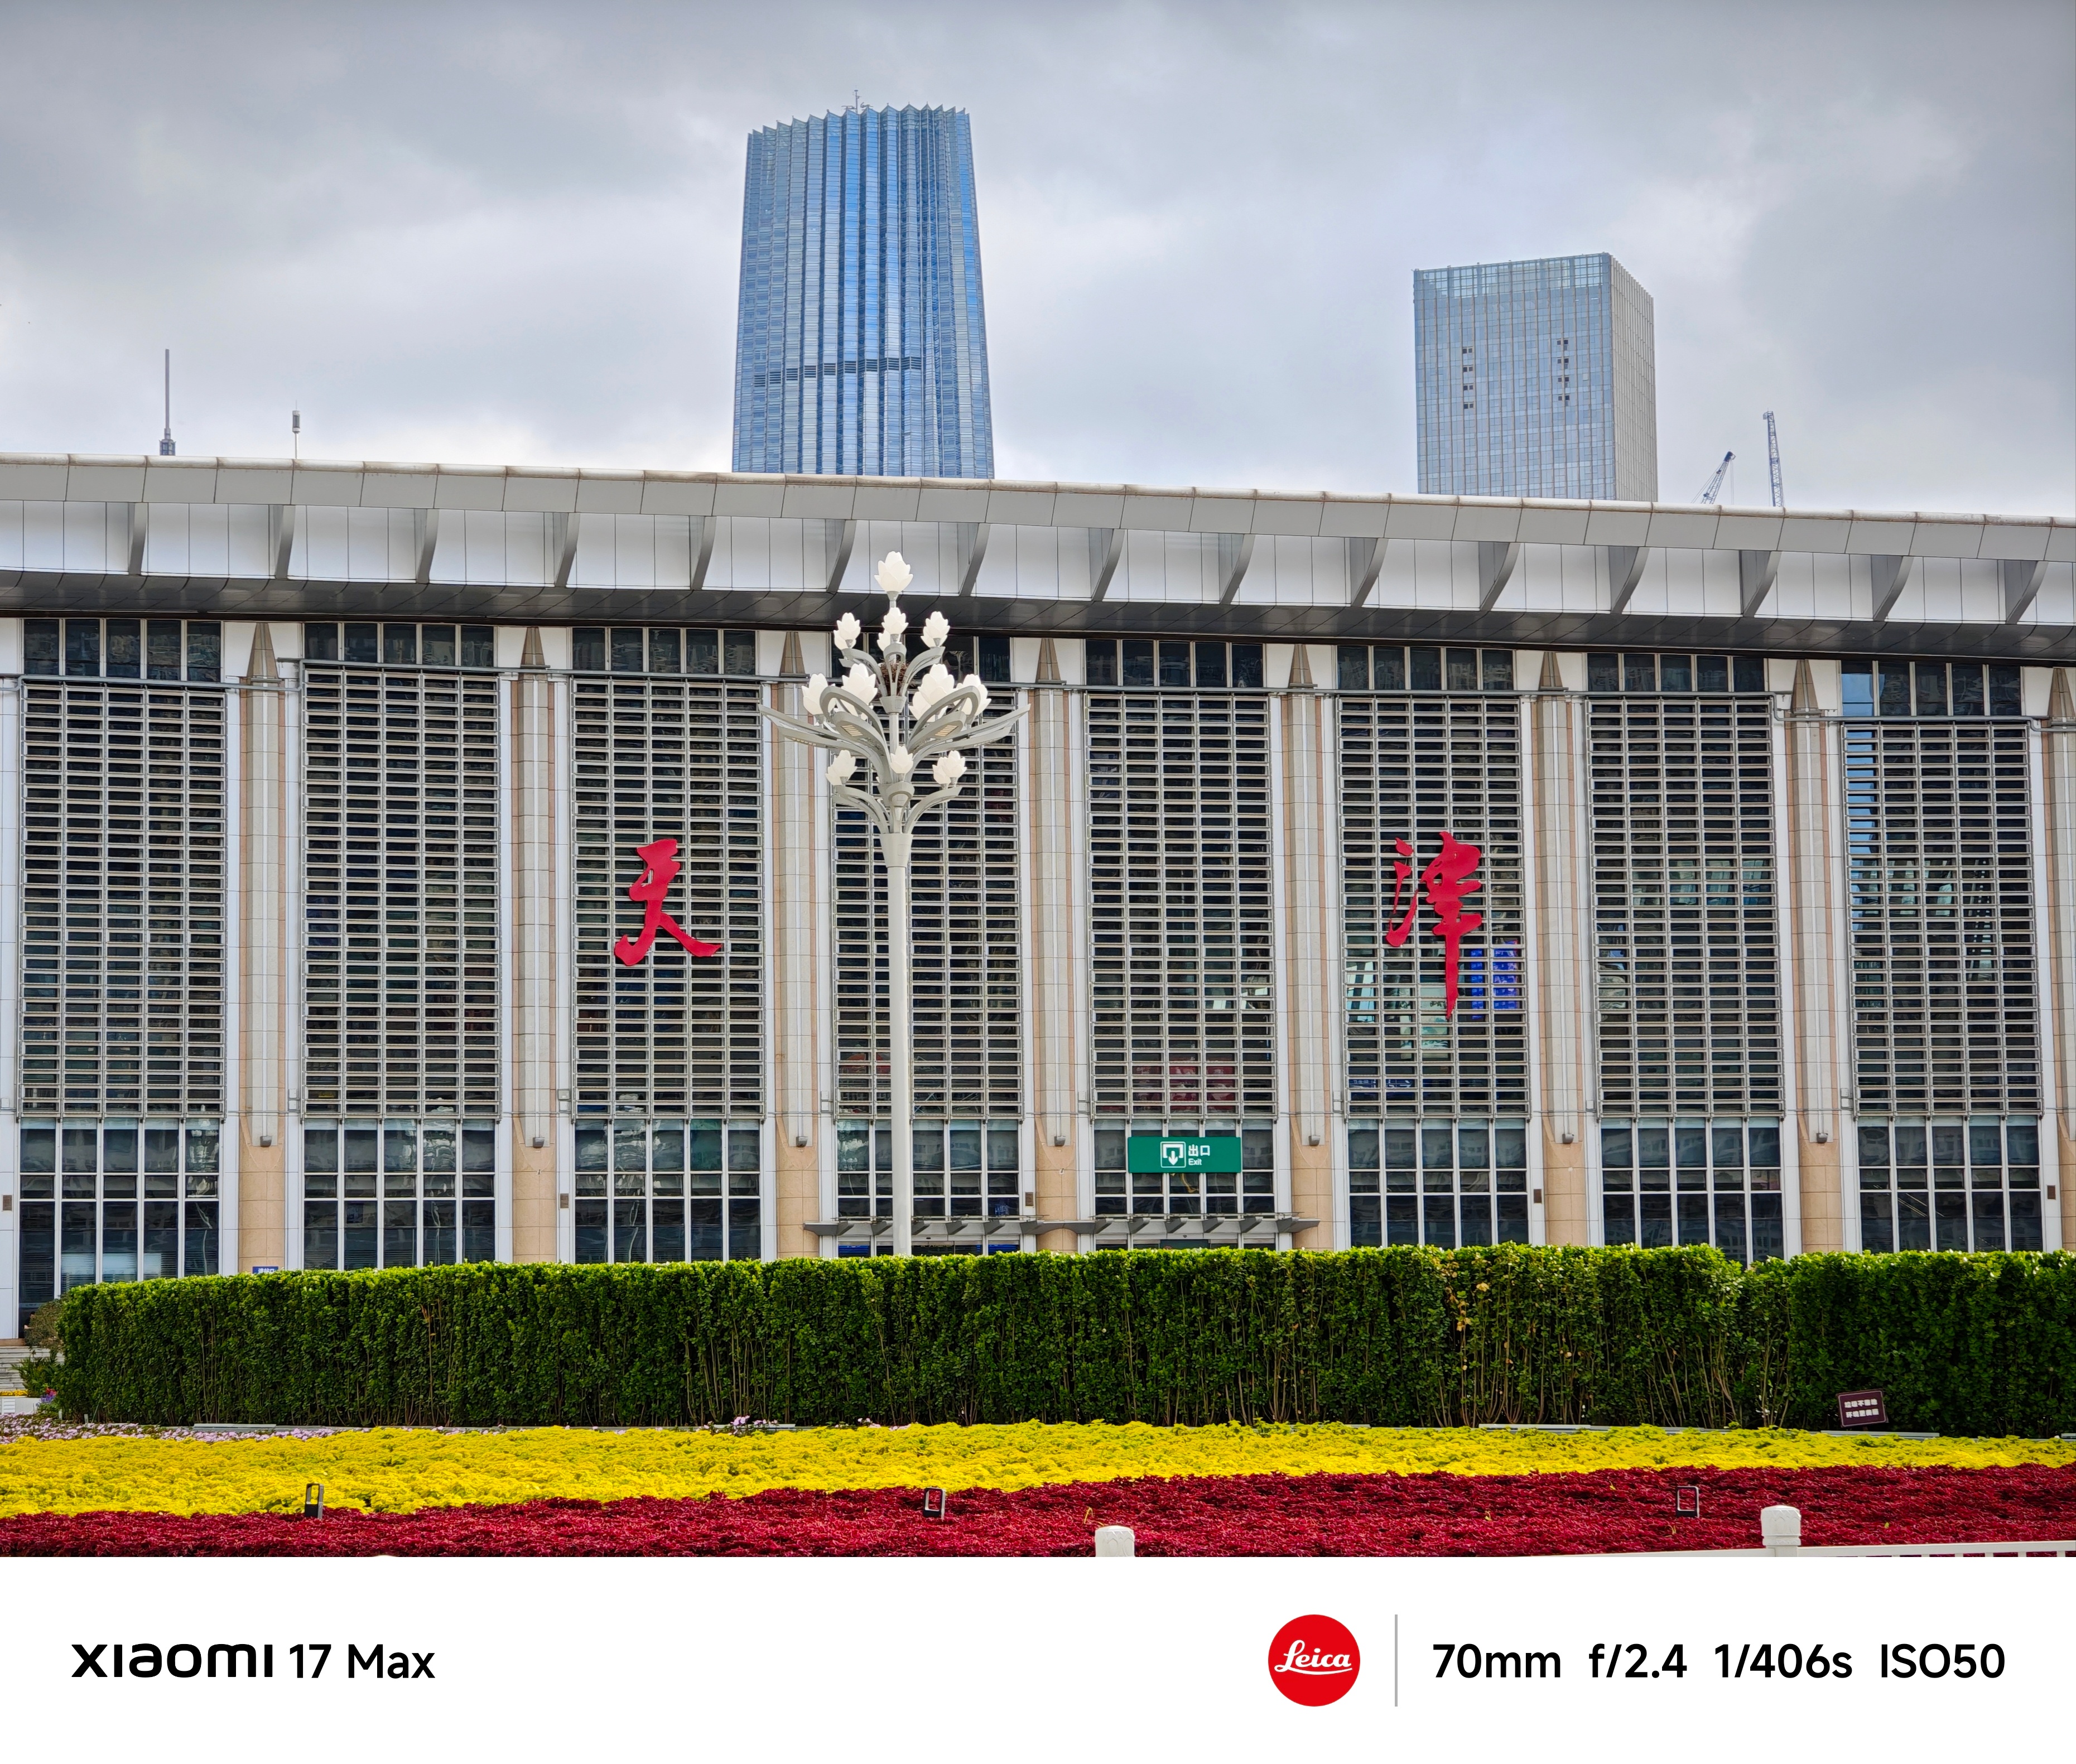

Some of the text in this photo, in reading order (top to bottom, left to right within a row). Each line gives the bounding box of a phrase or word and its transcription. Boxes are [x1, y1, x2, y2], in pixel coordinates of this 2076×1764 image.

[614, 839, 721, 966] 天
[1386, 832, 1482, 1018] 津
[1188, 1144, 1211, 1156] 出口
